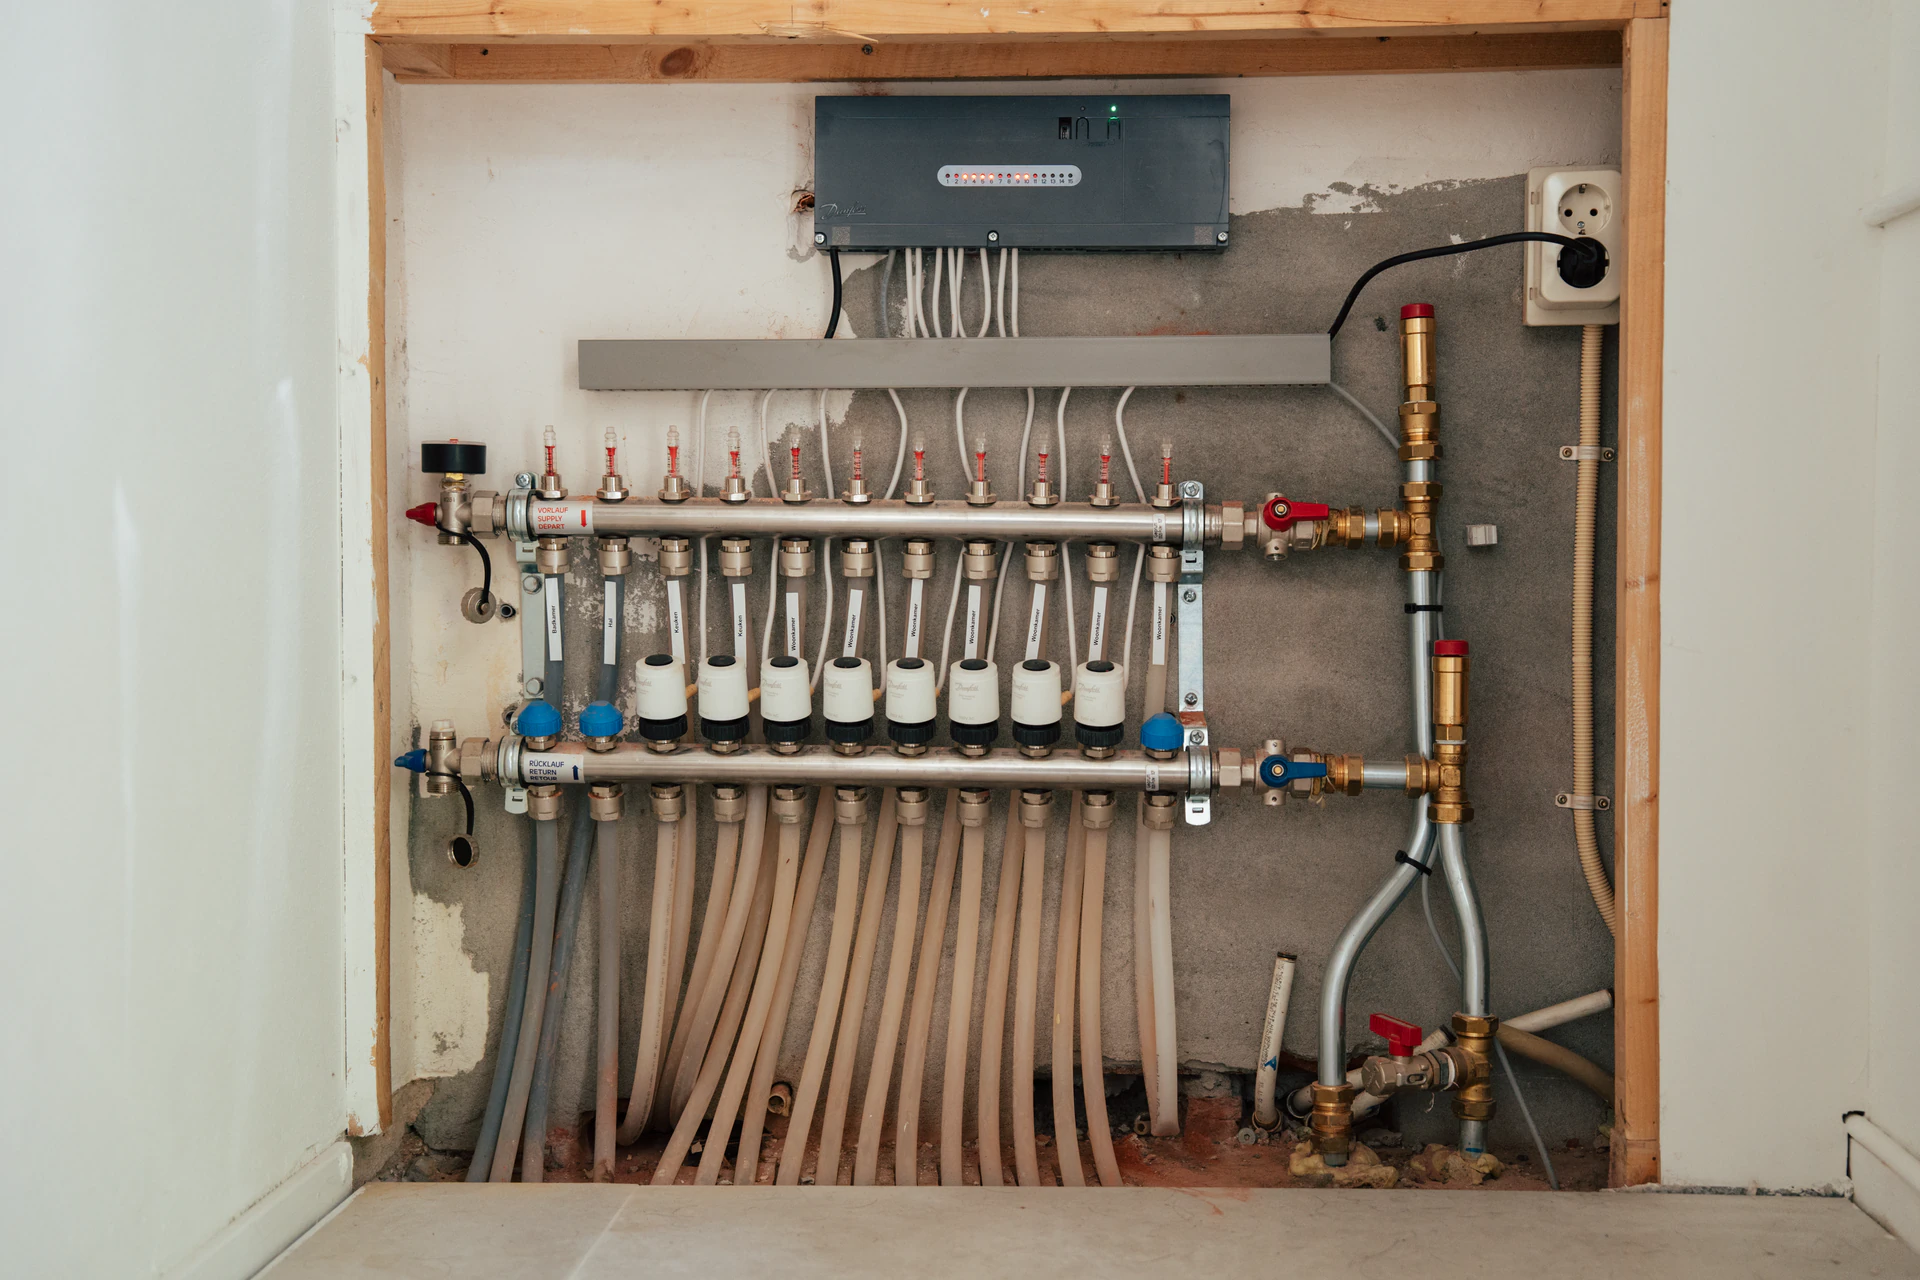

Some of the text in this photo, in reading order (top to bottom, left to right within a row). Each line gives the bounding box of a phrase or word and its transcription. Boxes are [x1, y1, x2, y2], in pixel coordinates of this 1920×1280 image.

[848, 614, 856, 648] Woonkamer
[1032, 608, 1040, 642] Woonkamer
[1094, 612, 1102, 646] Woonkamer
[529, 760, 564, 768] RÜCKLAUF
